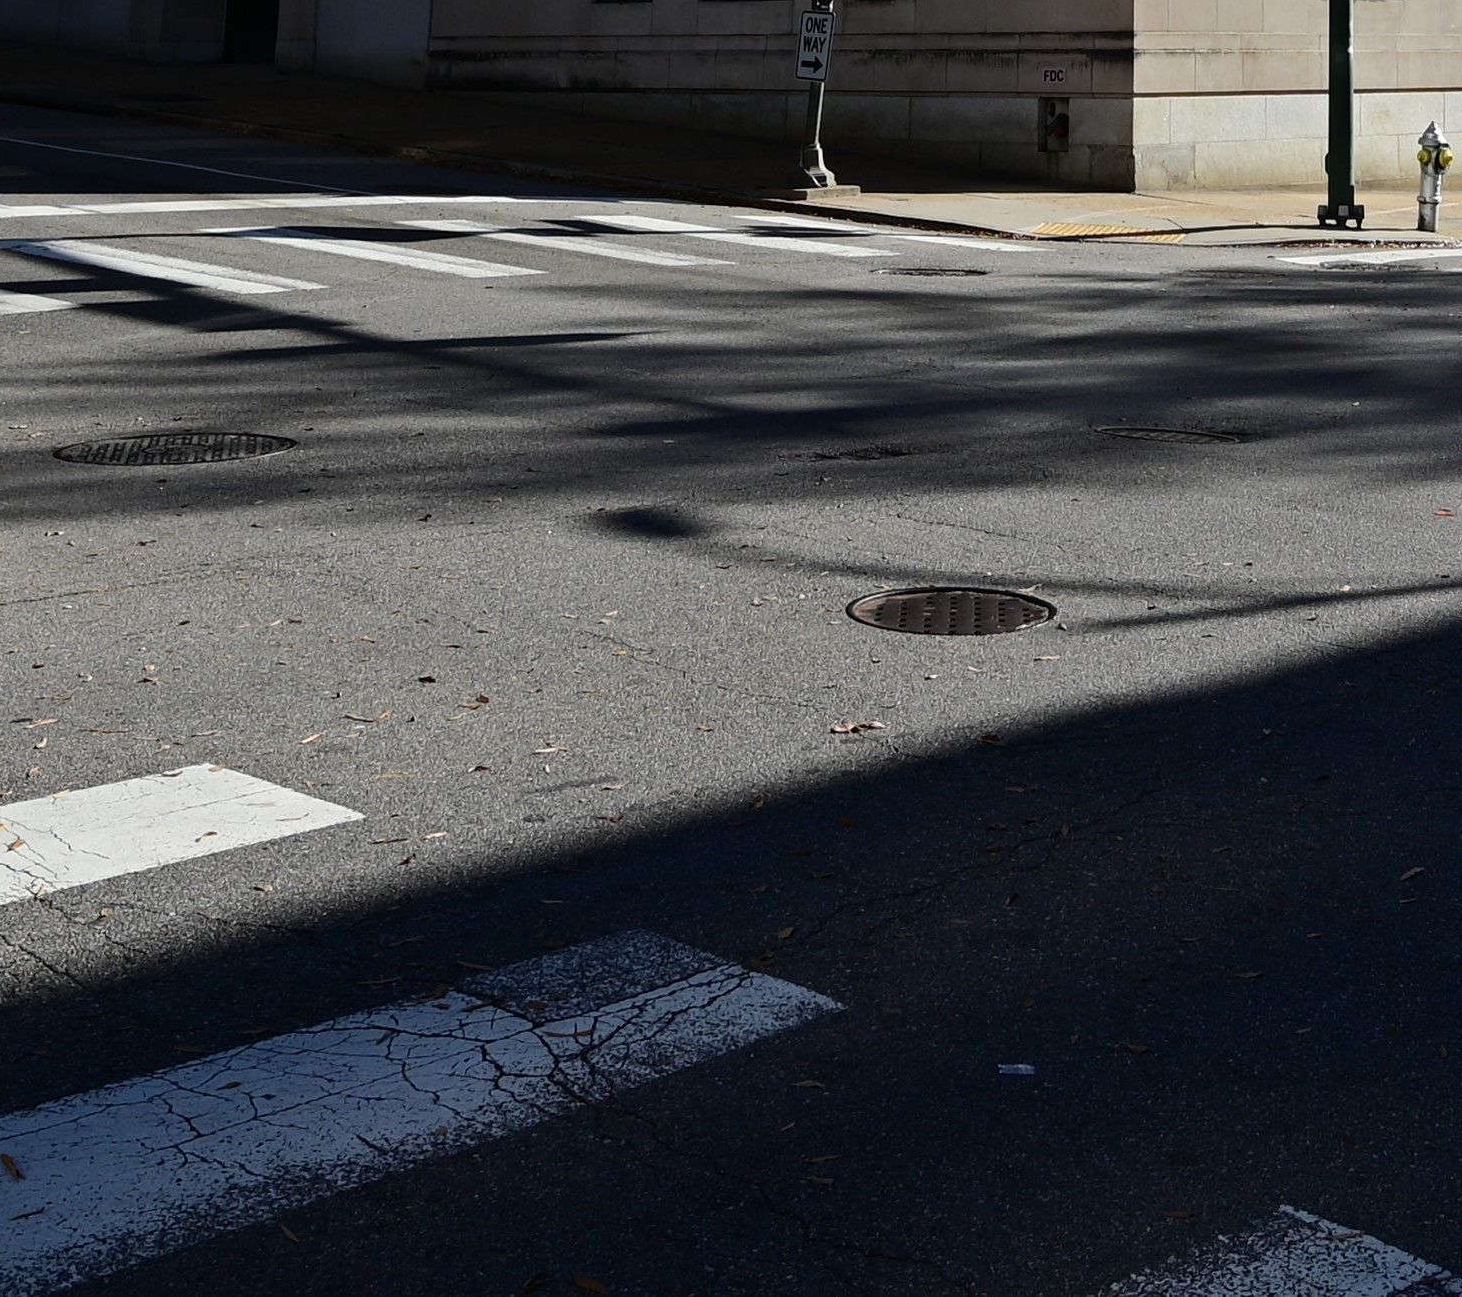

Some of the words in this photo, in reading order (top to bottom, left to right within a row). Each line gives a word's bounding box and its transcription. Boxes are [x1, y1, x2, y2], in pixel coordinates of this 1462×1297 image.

[805, 17, 828, 34] ONE
[803, 35, 827, 53] WAY
[1043, 69, 1064, 82] FDC
